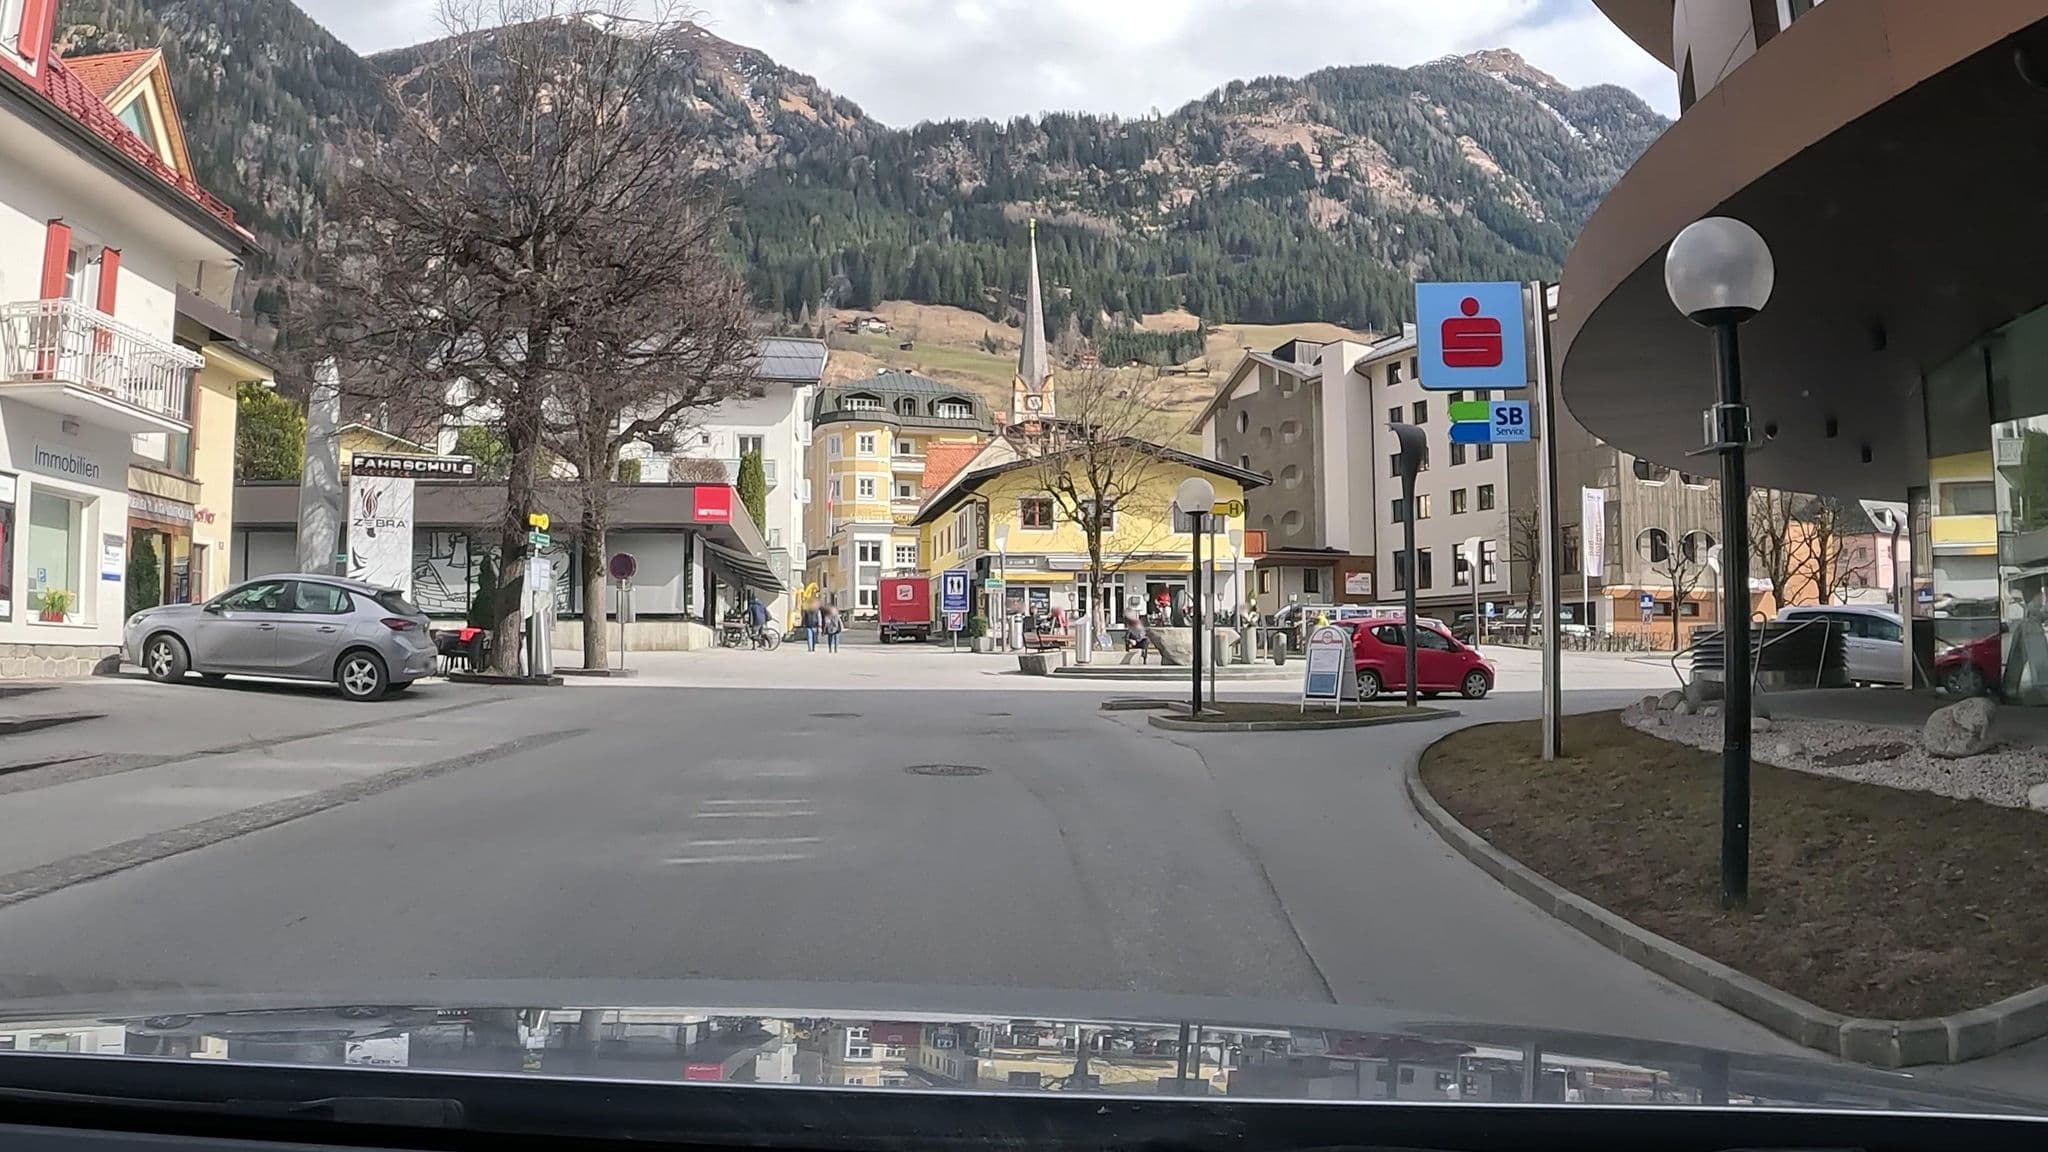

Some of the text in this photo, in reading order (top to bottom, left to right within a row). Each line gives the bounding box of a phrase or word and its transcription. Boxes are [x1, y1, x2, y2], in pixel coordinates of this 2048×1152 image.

[1494, 405, 1524, 426] SB
[1495, 426, 1525, 436] Service
[34, 444, 100, 480] Immobilien
[353, 457, 473, 474] FAHRSCHULE
[1229, 502, 1239, 514] H
